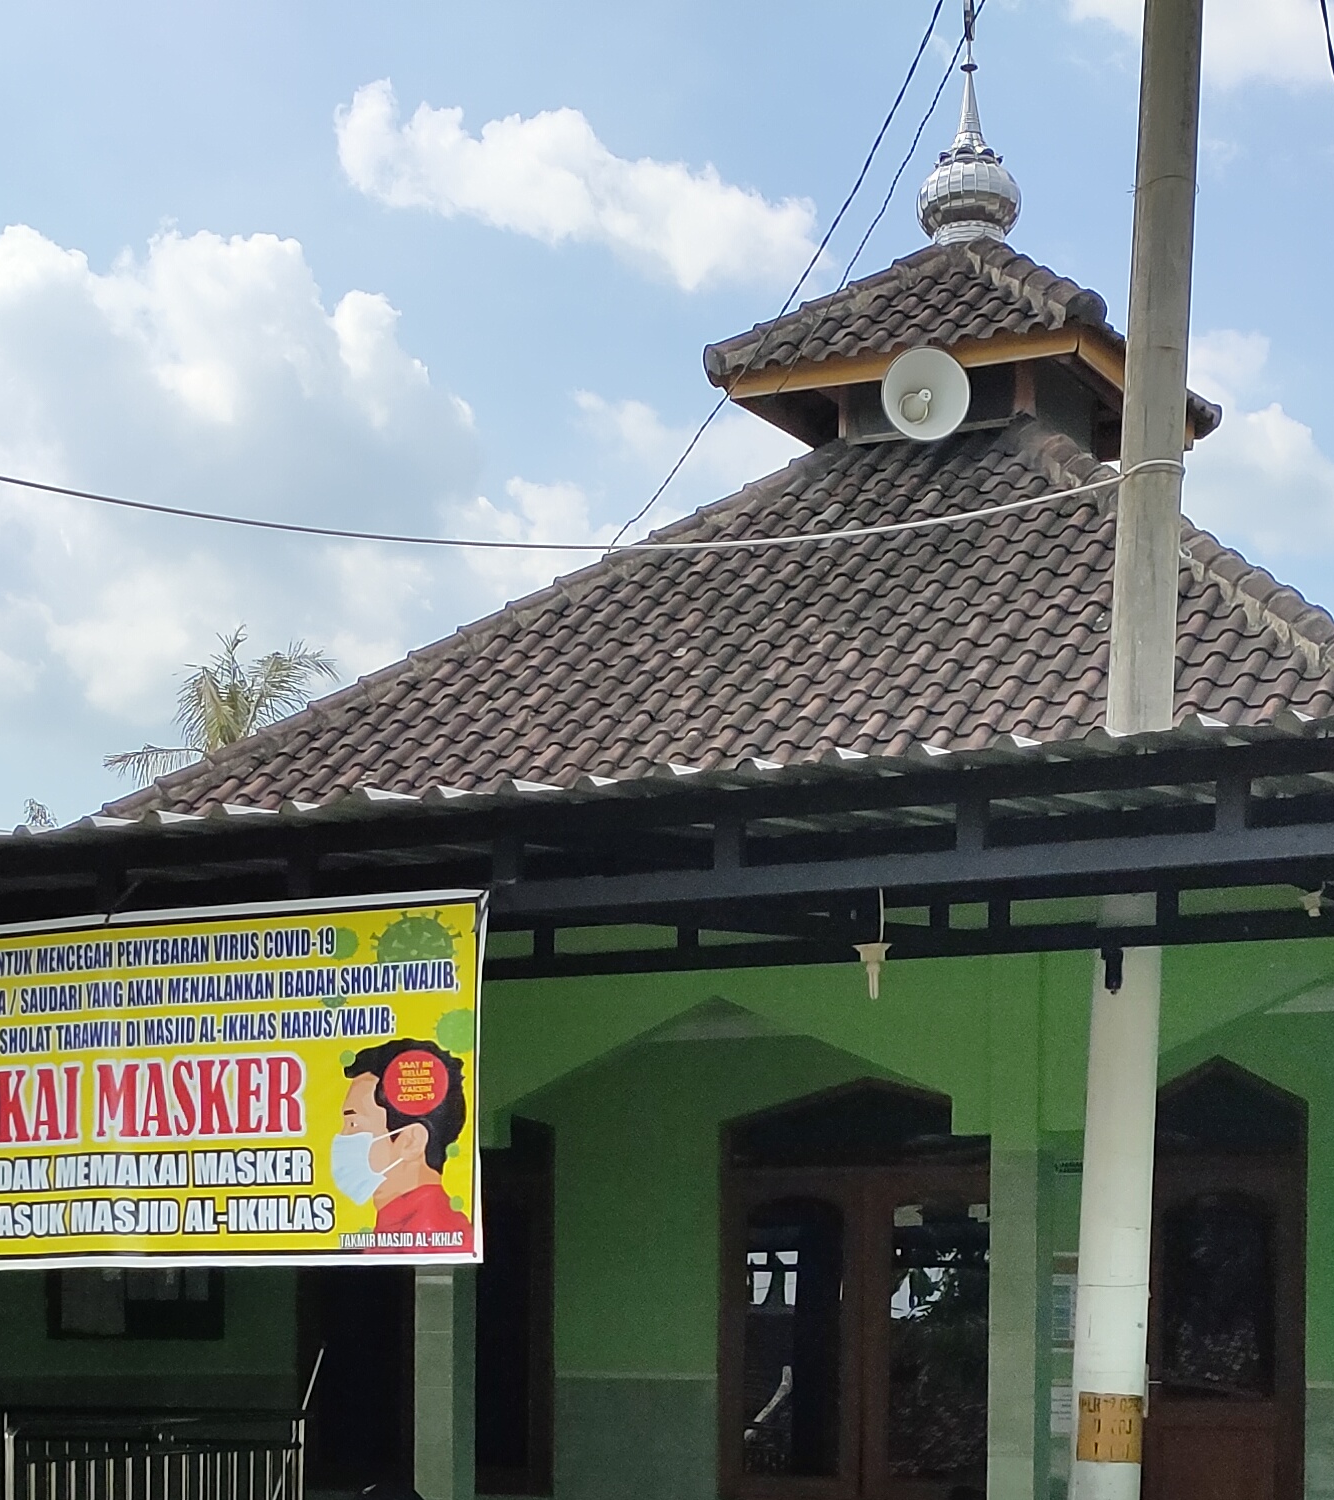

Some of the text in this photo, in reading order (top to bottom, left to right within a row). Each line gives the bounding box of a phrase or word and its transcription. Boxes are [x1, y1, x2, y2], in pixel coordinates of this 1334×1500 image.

[36, 943, 112, 973] MENCEGAH
[118, 935, 209, 967] PENYEBARAN
[214, 931, 259, 962] VIRUS
[265, 927, 335, 958] COVID-19
[9, 989, 17, 1014] /
[21, 985, 82, 1014] SAUDARI
[85, 981, 123, 1009] YANG
[127, 979, 163, 1006] AKAN
[168, 972, 273, 1003] MENJALANKAN
[279, 968, 336, 998] IBADAH
[341, 964, 399, 994] SHOLAT
[403, 960, 460, 992] WAJIB,
[0, 1025, 52, 1054] SHOLAT
[56, 1021, 121, 1051] TARAWIH
[127, 1019, 141, 1046] DI
[144, 1015, 196, 1046] MASJID
[199, 1012, 276, 1043] AL-IKHLAS
[398, 1061, 420, 1069] SAAT
[96, 1057, 304, 1138] MASKER
[397, 1093, 435, 1102] COVID-19
[55, 1150, 188, 1190] MEMAKAI
[193, 1147, 313, 1186] MASKER
[70, 1197, 178, 1235] MASJID
[184, 1194, 334, 1233] AL-IKHLAS
[339, 1231, 463, 1248] TAKMIR MASJID AL-IKHLAS
